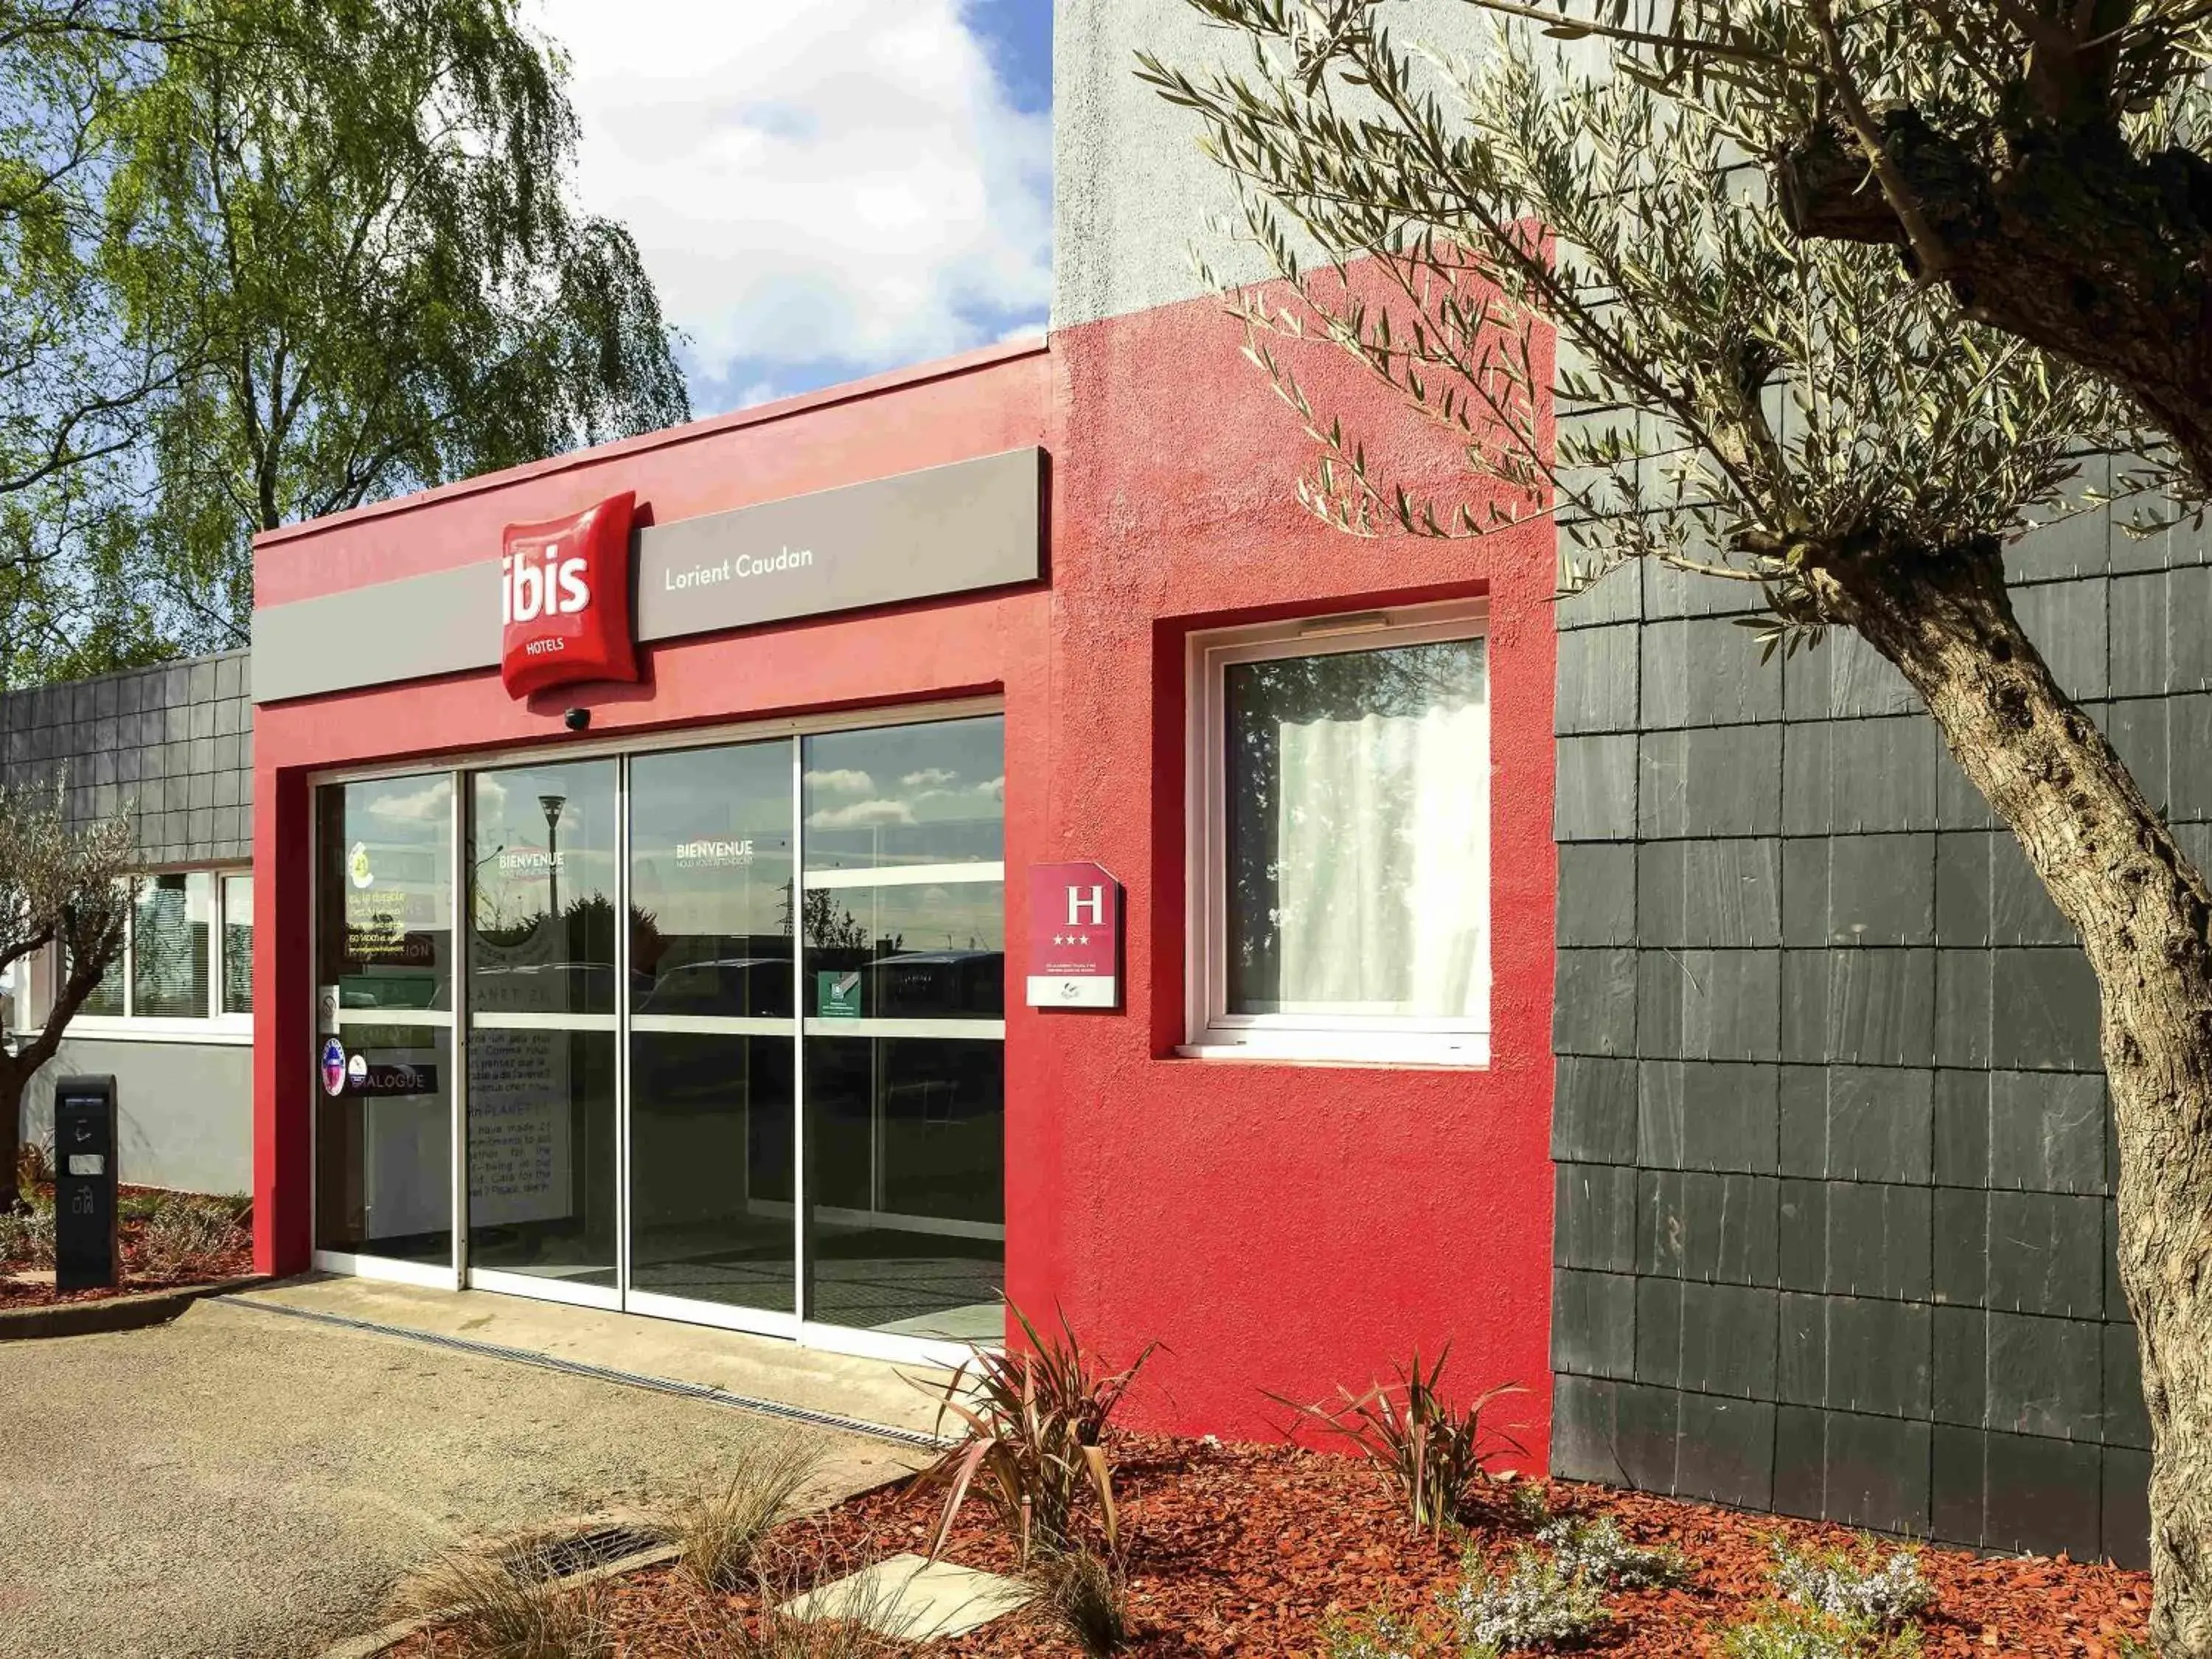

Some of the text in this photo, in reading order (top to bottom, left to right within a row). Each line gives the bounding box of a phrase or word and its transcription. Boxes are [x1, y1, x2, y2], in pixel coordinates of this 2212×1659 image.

[666, 546, 813, 591] Lorient Caudan
[503, 544, 590, 625] ibis
[526, 637, 564, 656] HOTELS
[676, 840, 754, 859] BIENVENUE
[498, 852, 564, 869] BIENVENUE
[1064, 886, 1106, 925] H
[359, 1073, 425, 1088] ALOGUE
